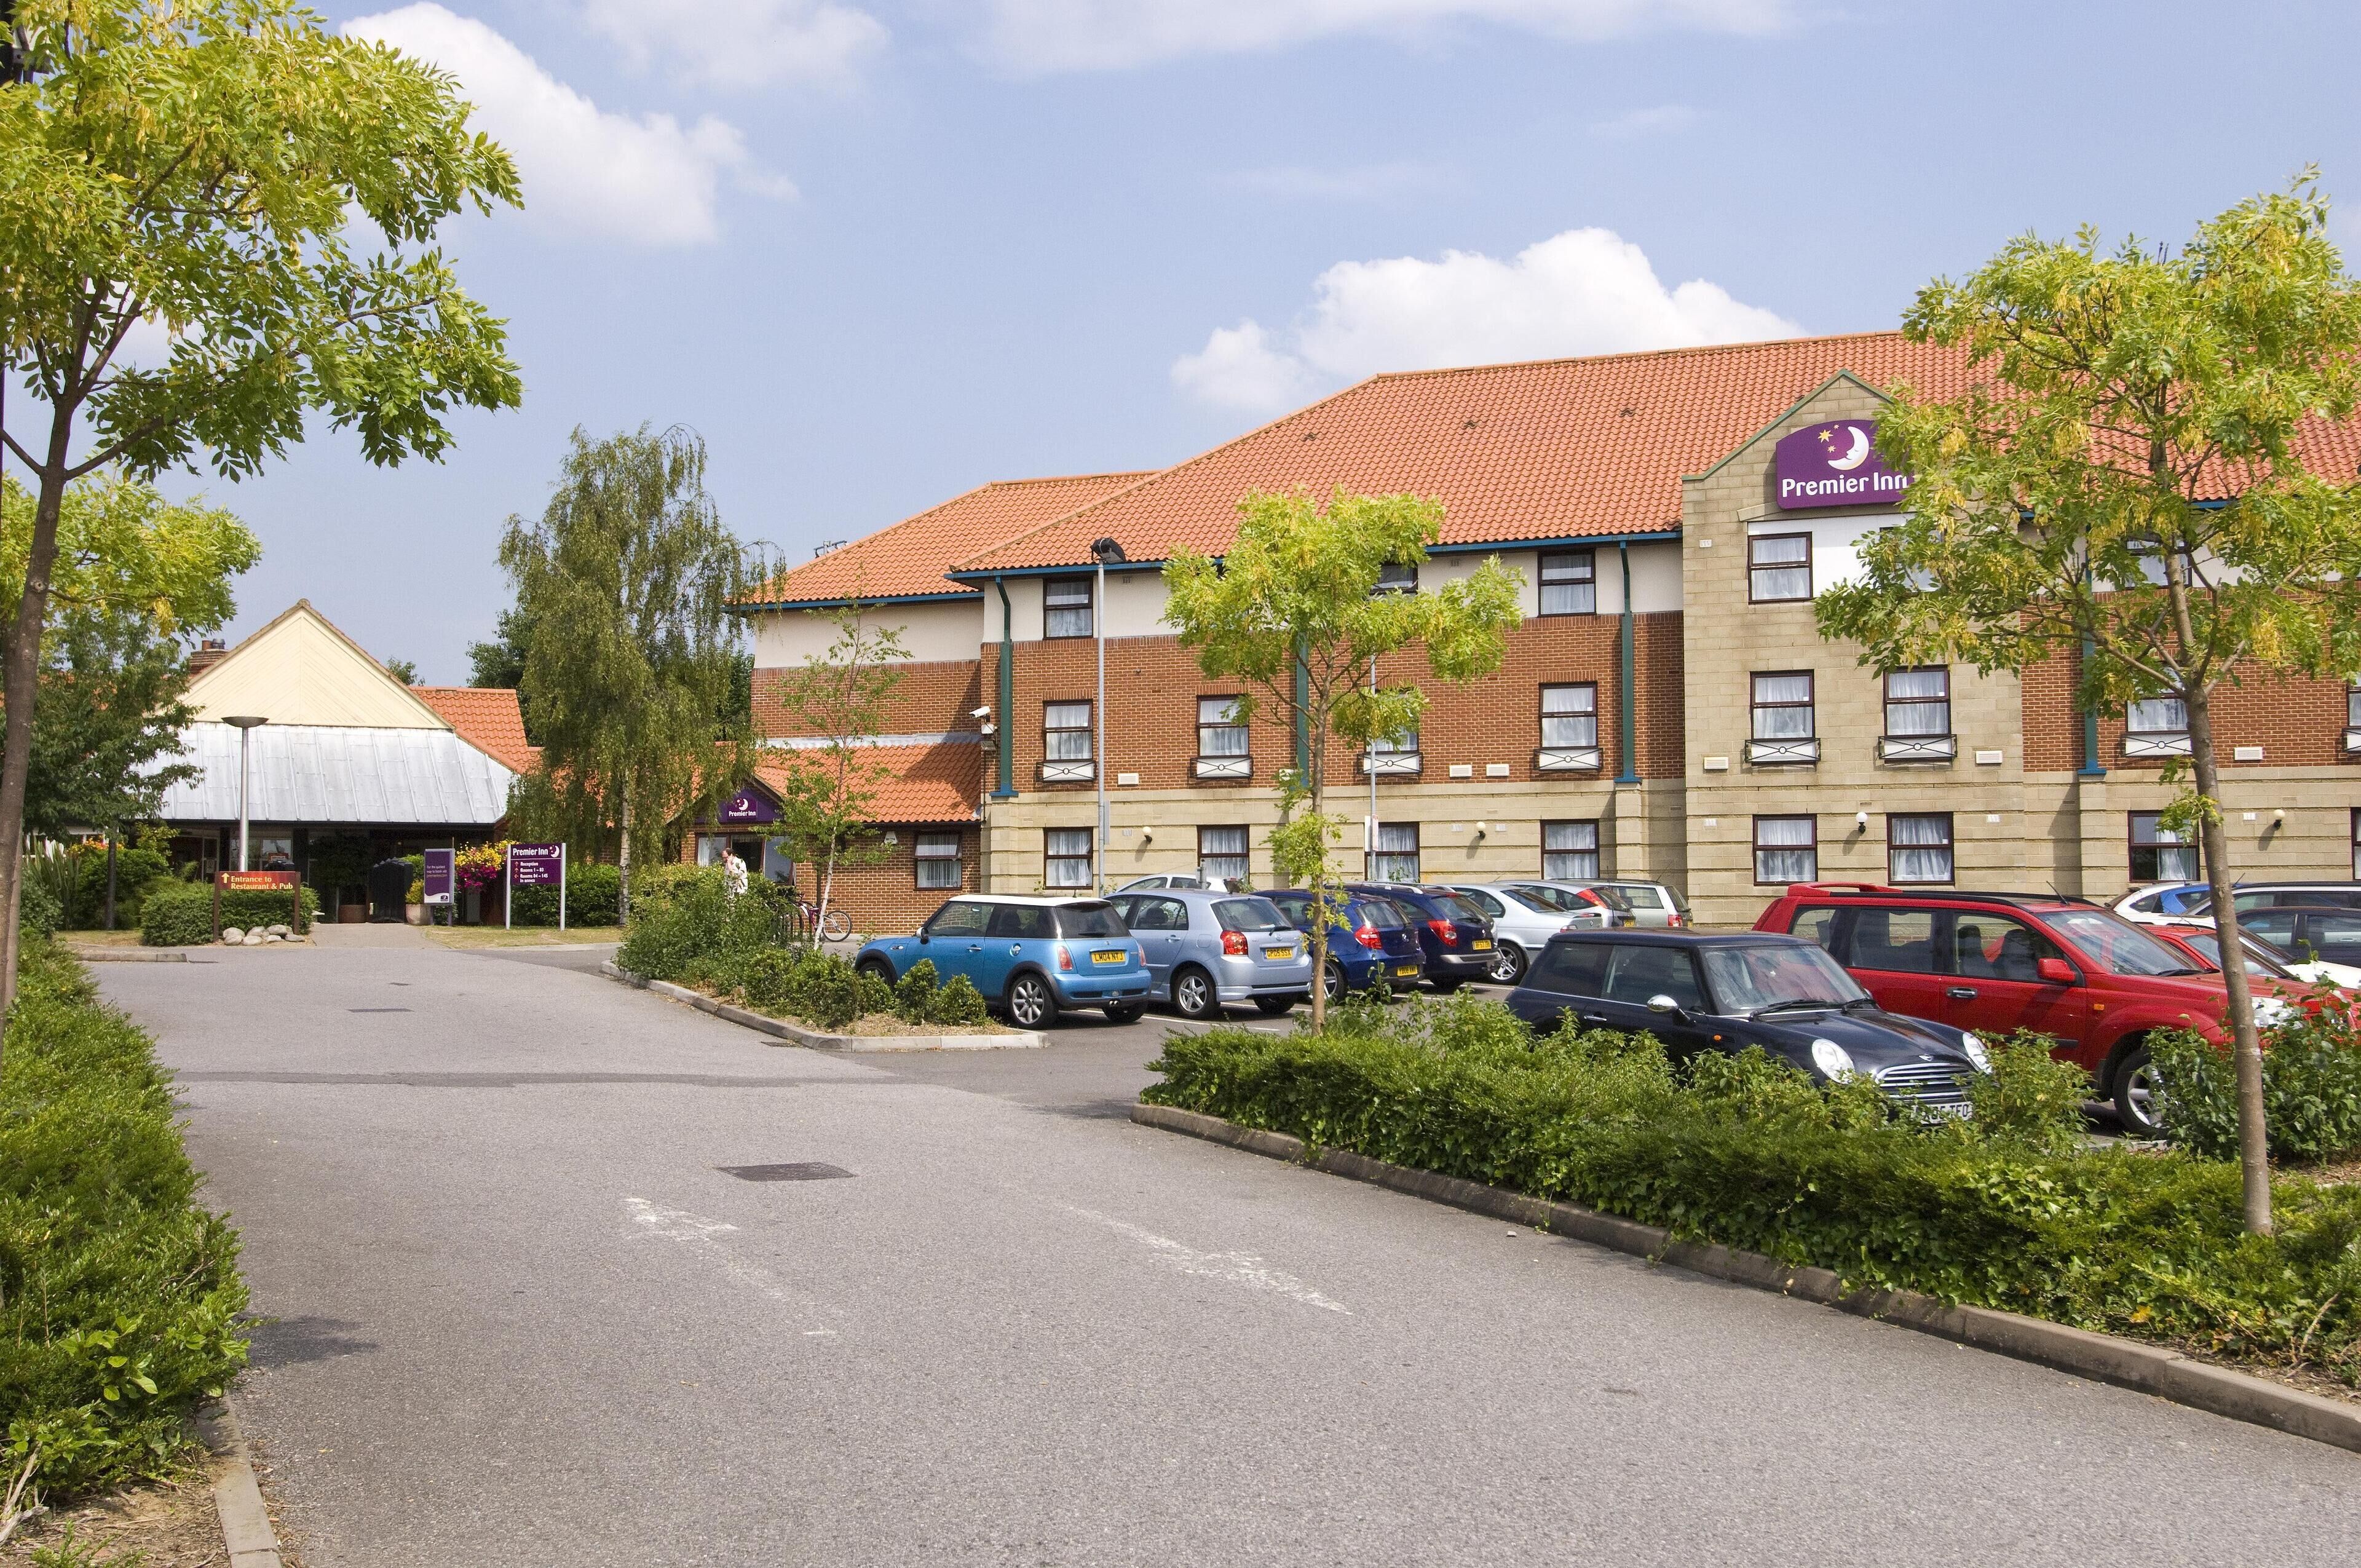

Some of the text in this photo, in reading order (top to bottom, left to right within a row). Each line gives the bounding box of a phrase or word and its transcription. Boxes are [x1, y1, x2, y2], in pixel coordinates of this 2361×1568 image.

[1782, 472, 1908, 497] Premier Inn
[513, 847, 537, 856] Premier
